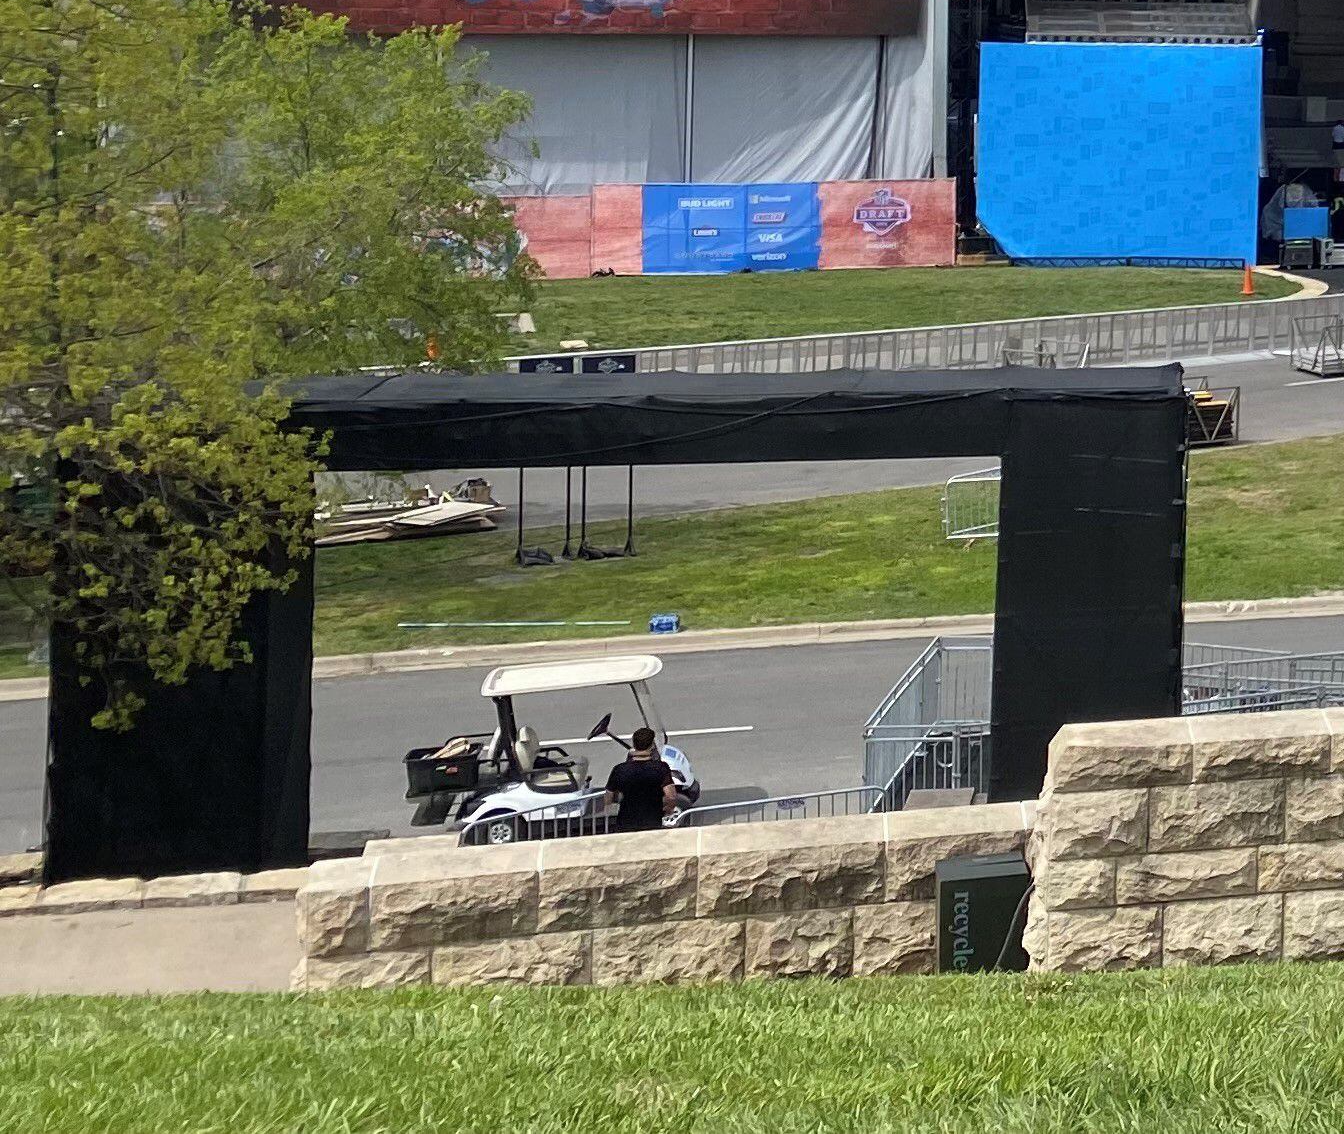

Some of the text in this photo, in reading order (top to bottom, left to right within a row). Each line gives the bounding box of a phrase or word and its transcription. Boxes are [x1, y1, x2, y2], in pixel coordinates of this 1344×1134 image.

[859, 209, 906, 219] DRAFT
[759, 233, 783, 243] VISA
[951, 889, 975, 971] recycle
